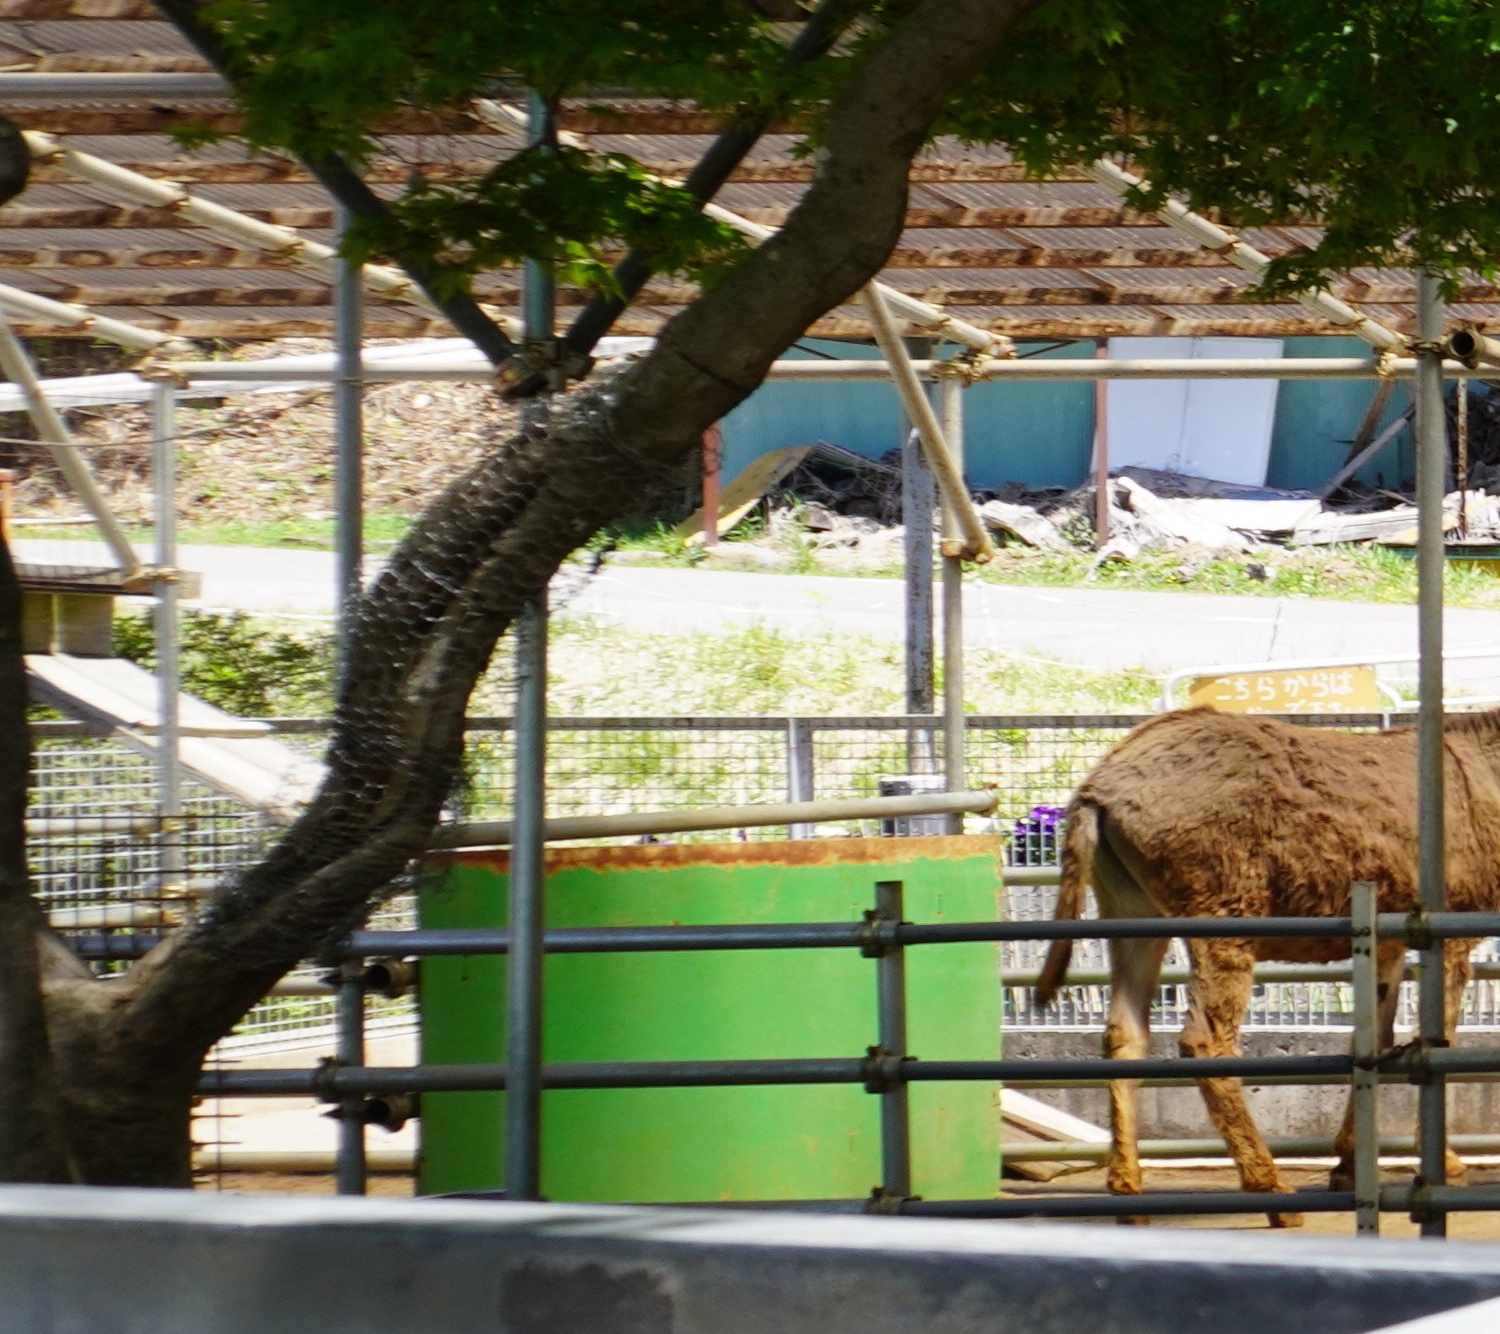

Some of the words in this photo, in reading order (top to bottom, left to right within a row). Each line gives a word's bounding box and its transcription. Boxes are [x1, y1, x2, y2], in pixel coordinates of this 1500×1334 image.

[1215, 672, 1353, 701] こちらからは
